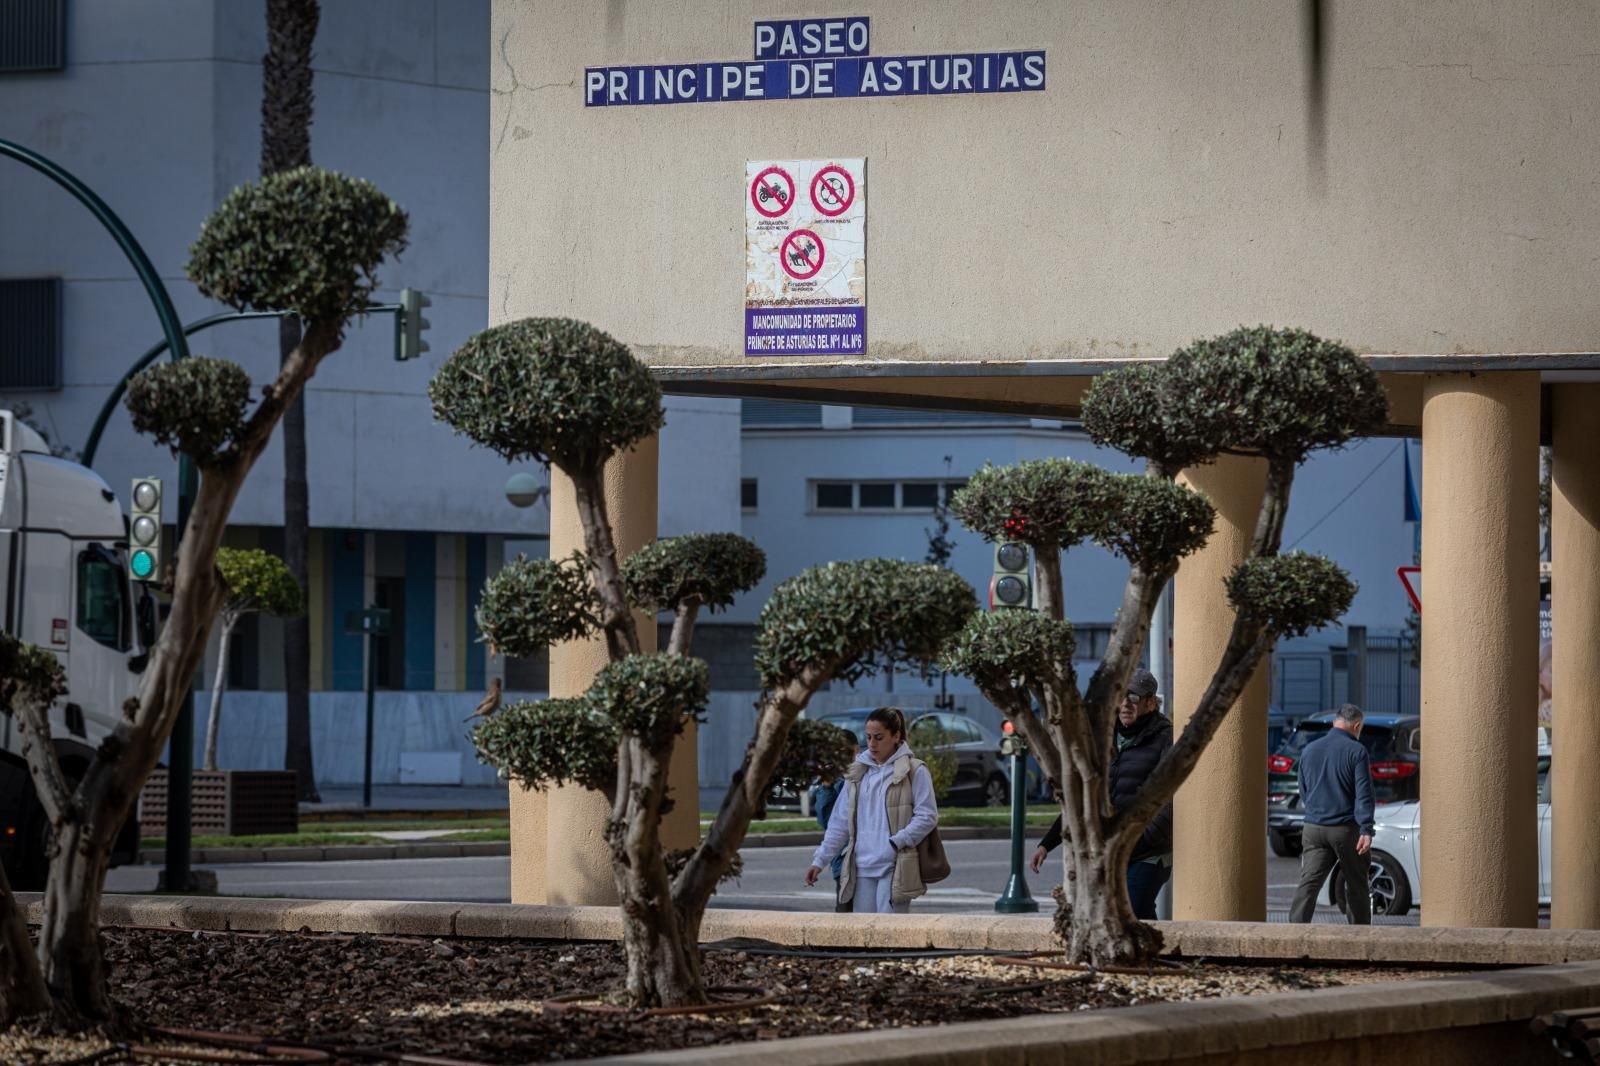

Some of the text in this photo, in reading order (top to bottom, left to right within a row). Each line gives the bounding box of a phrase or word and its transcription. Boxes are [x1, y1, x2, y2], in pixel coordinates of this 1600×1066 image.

[755, 22, 868, 56] PASEO
[586, 55, 1044, 104] PRINCIPE DE ASTURIAS
[753, 314, 856, 329] MANCOMUNIDAD DE PROPIETARIOS
[777, 335, 785, 349] DE
[786, 335, 816, 349] ASTURIAS
[818, 335, 829, 348] DEL
[842, 334, 850, 348] AL
